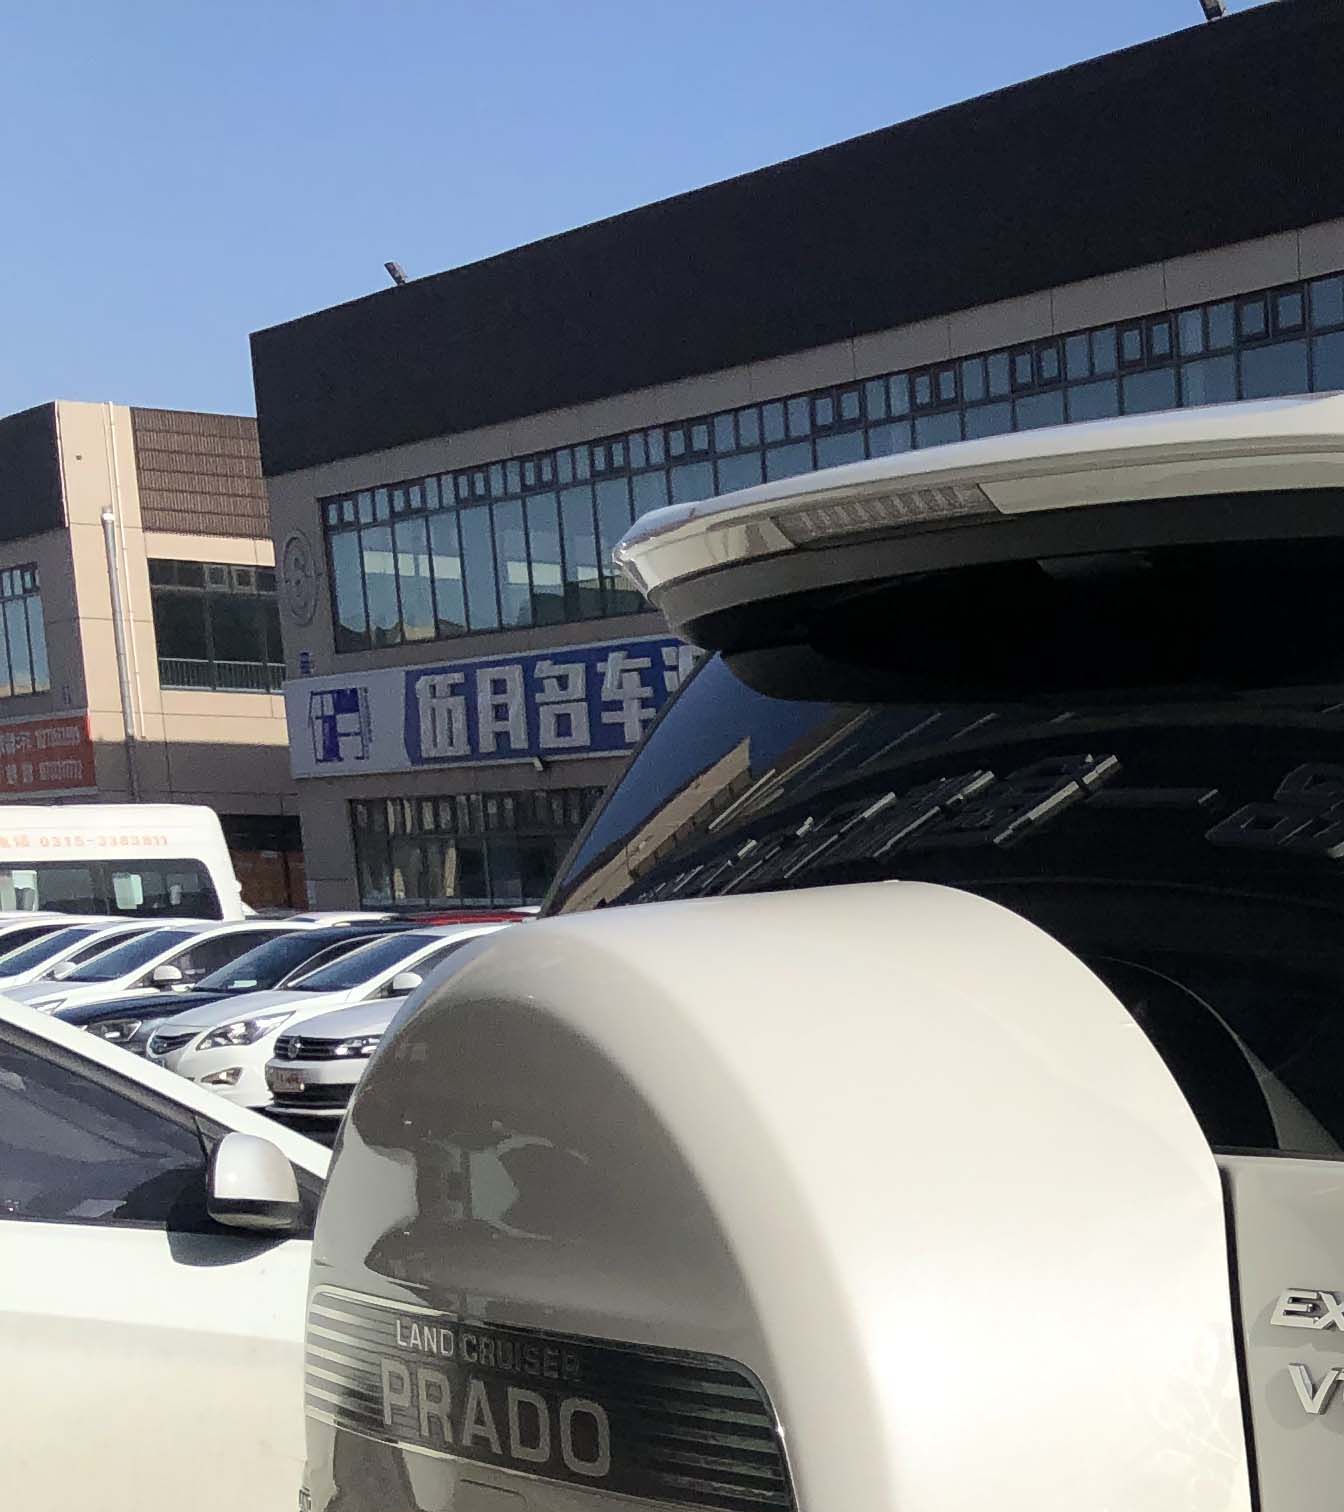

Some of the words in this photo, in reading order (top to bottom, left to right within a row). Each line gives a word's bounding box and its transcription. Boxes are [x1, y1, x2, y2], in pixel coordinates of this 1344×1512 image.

[395, 1319, 455, 1357] LAND
[462, 1333, 581, 1383] CRUISER
[380, 1357, 612, 1478] PRADO
